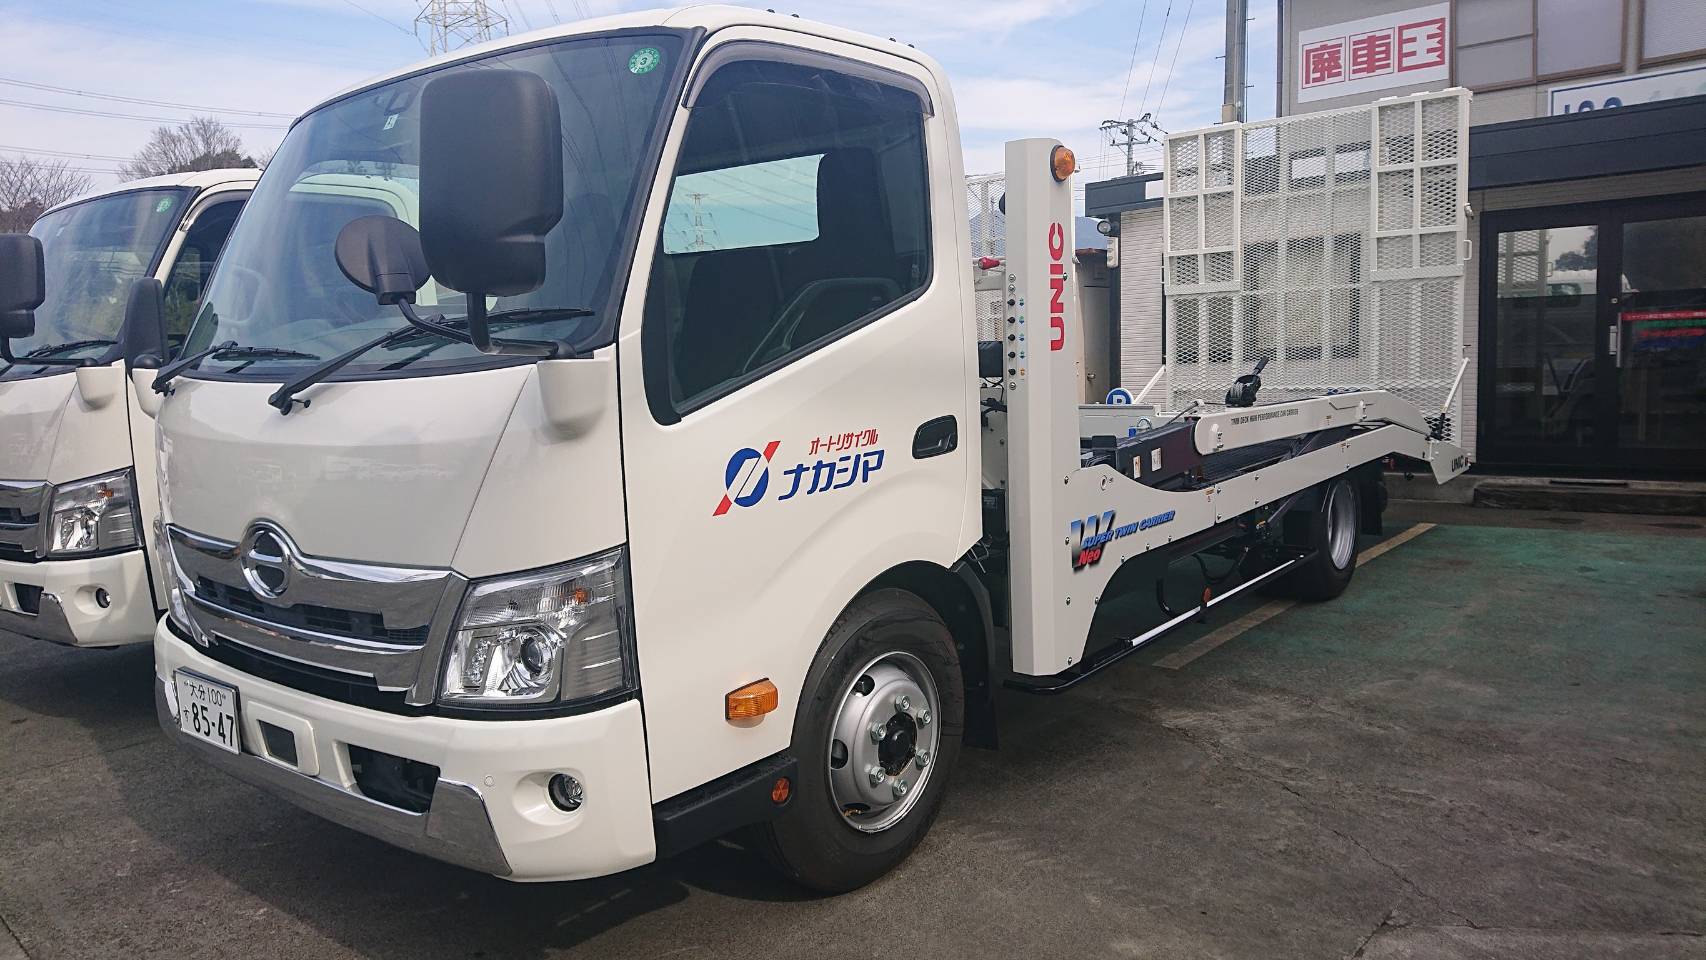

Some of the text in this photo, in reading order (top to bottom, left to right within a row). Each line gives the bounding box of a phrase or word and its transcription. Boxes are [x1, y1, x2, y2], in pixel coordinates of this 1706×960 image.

[1048, 222, 1065, 351] UNIC
[808, 428, 879, 455] オートリサイクル
[778, 449, 885, 501] ナカシマ
[1081, 509, 1176, 549] SUPER TWIN CARRIER
[1078, 547, 1103, 566] Neo
